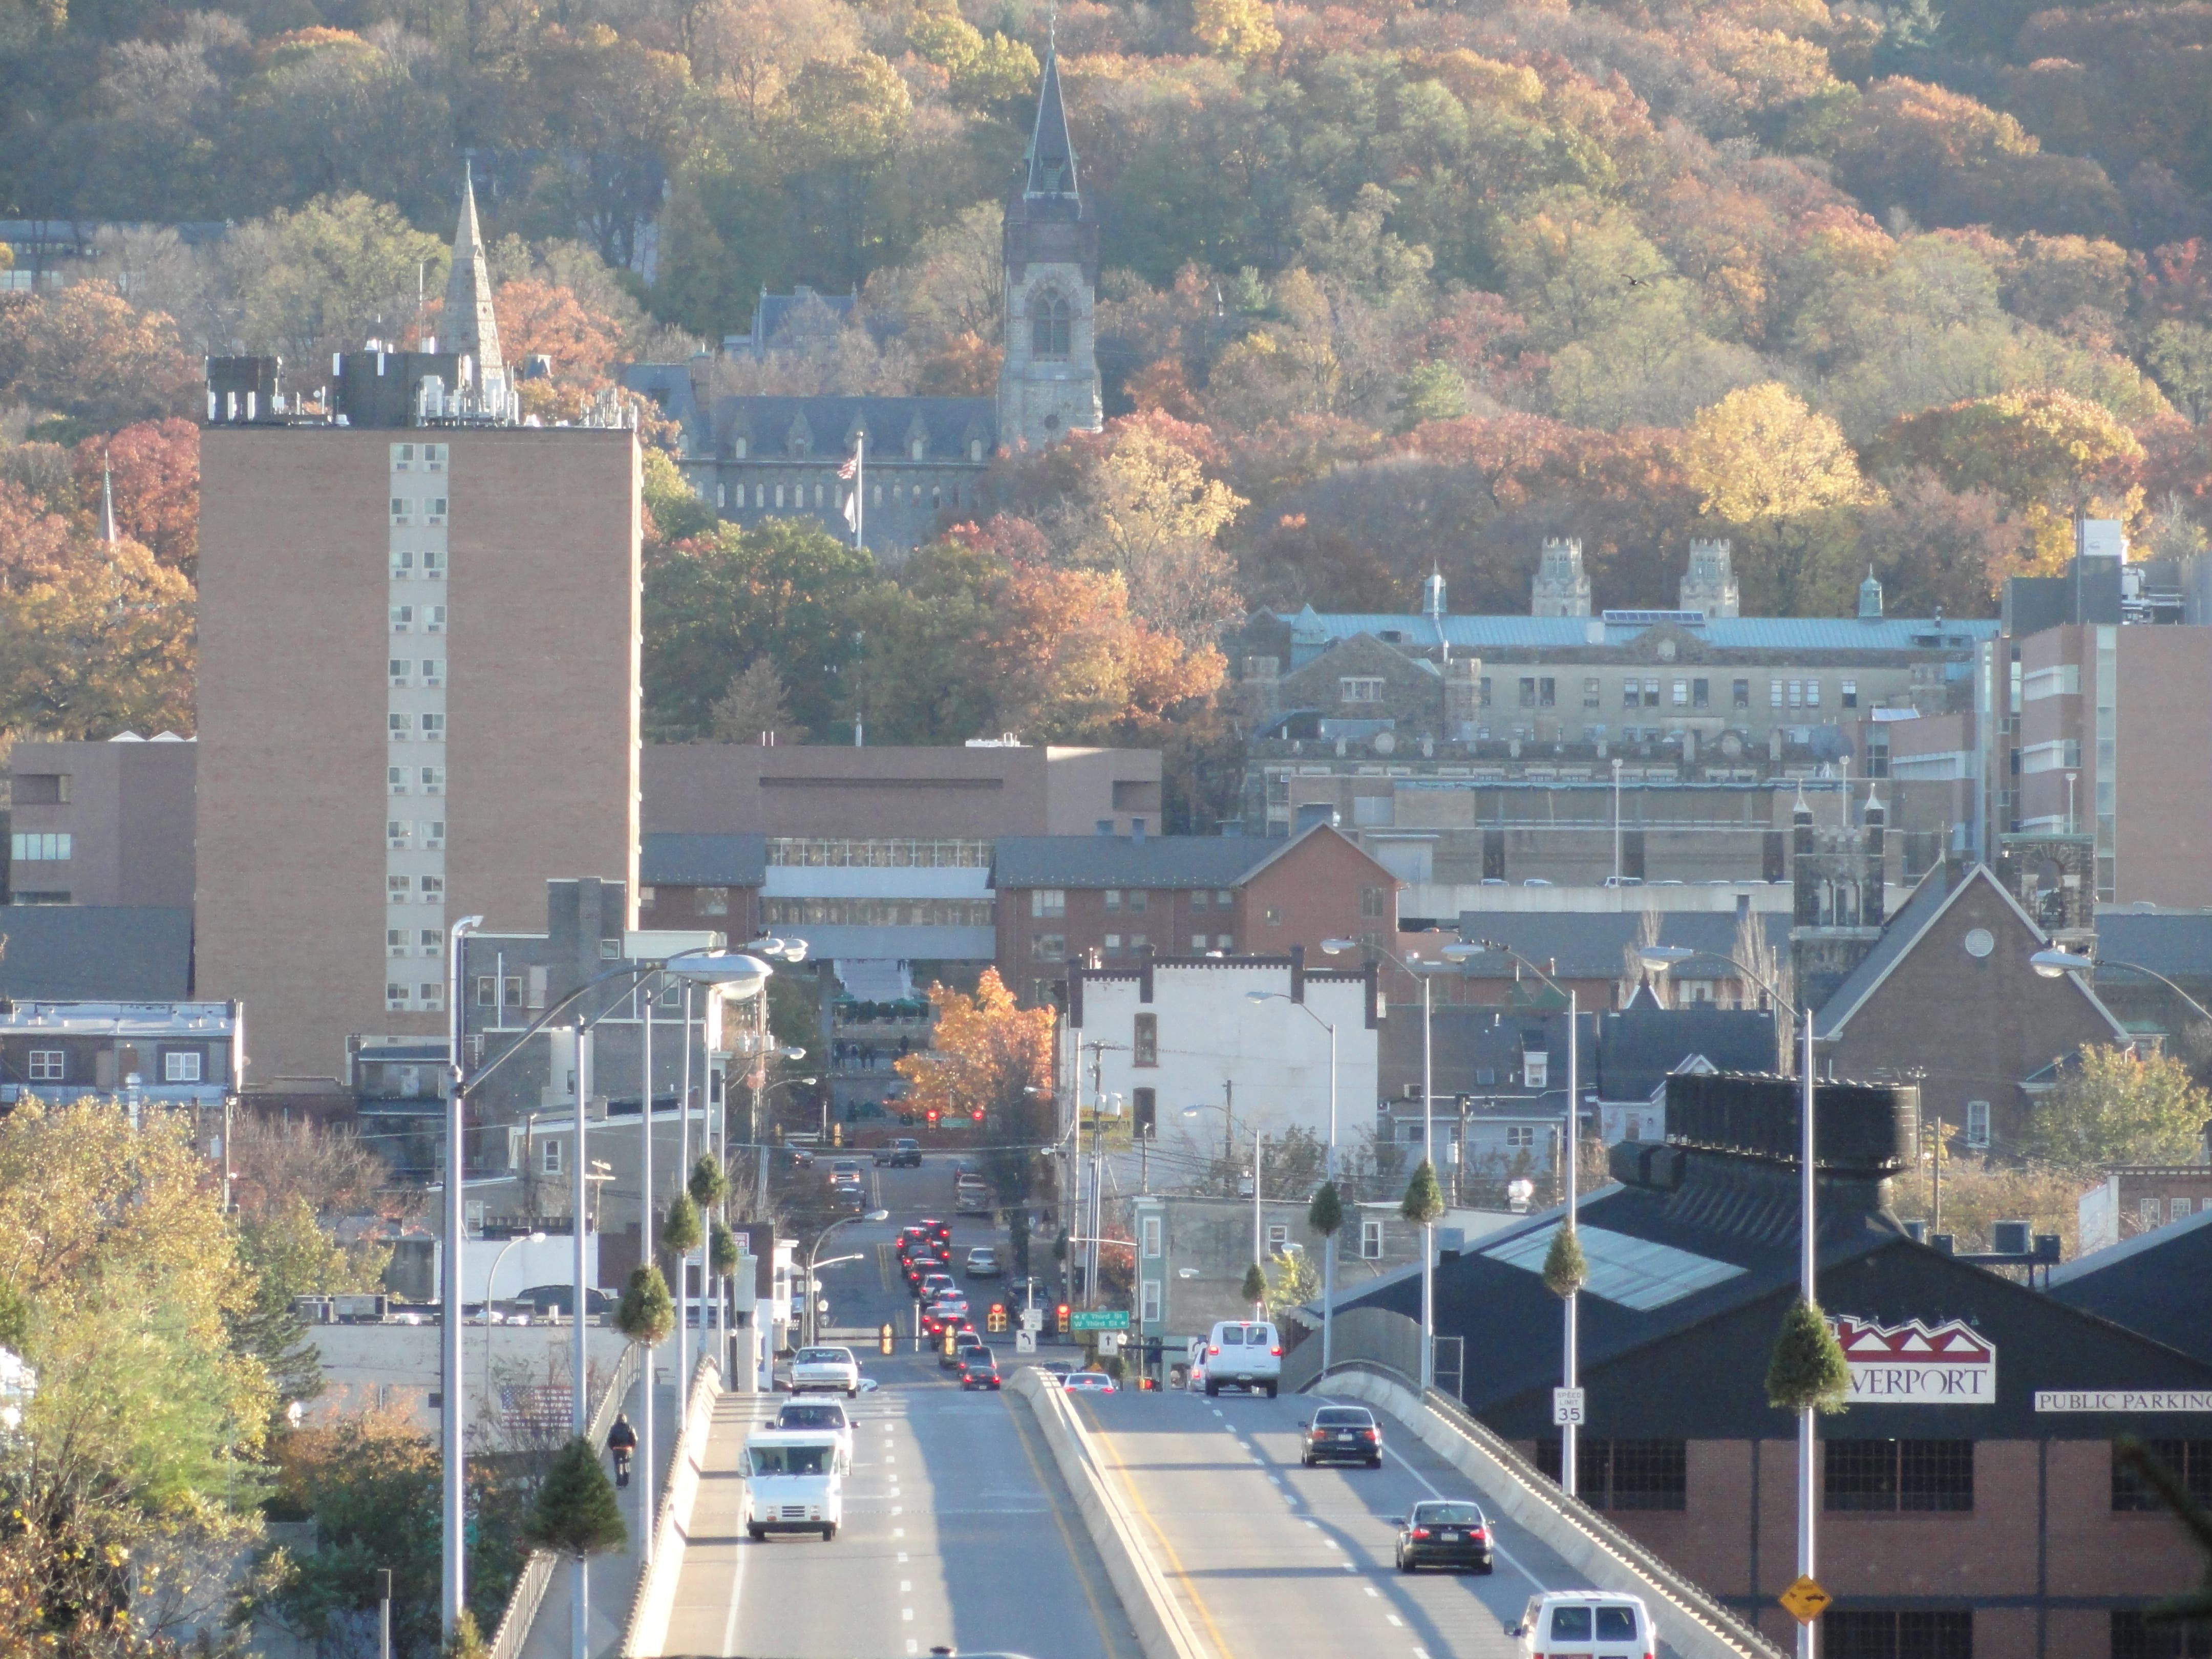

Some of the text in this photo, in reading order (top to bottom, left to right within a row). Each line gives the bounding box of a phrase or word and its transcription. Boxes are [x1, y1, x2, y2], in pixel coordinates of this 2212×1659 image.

[1850, 1369, 1987, 1395] VERPORT
[2040, 1394, 2116, 1409] PUBLIC
[1559, 1408, 1581, 1421] 35
